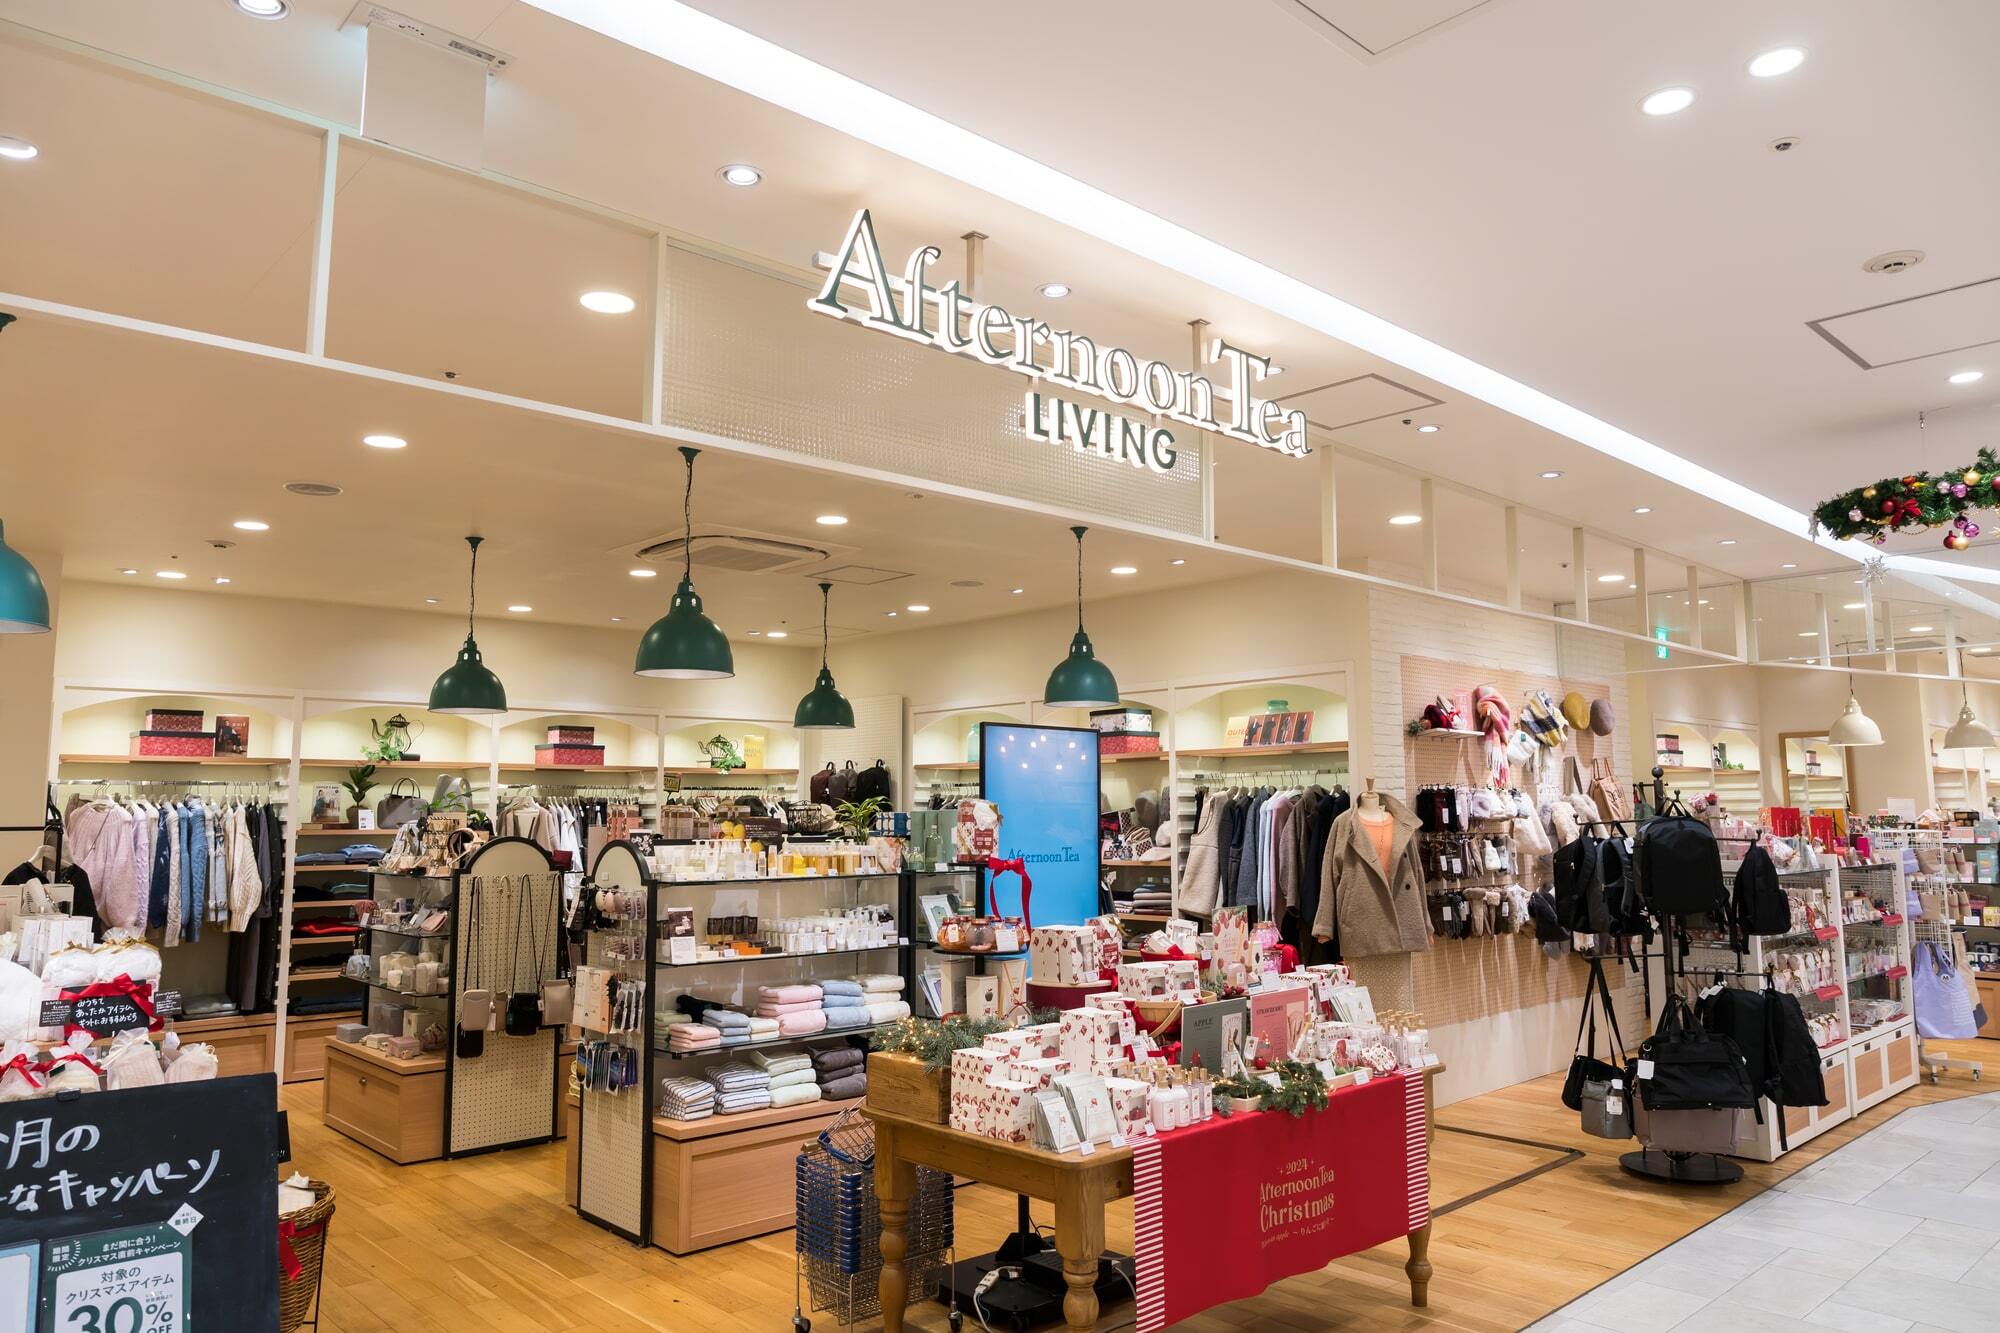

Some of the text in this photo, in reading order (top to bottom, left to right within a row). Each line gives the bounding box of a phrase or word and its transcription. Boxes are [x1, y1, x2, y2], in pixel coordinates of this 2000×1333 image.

[807, 208, 1313, 459] Afternoon Tea
[1024, 391, 1178, 473] LIVING
[1008, 847, 1080, 863] Afternoon Tea
[0, 1117, 101, 1169] 月の
[0, 1149, 221, 1212] なキャンペーン
[1260, 1165, 1335, 1205] Afternoon Tea
[1286, 1158, 1308, 1175] 2024
[1260, 1193, 1335, 1233] Christmas
[65, 1273, 175, 1305] クリスマスアイテム
[100, 1266, 141, 1284] 対象の
